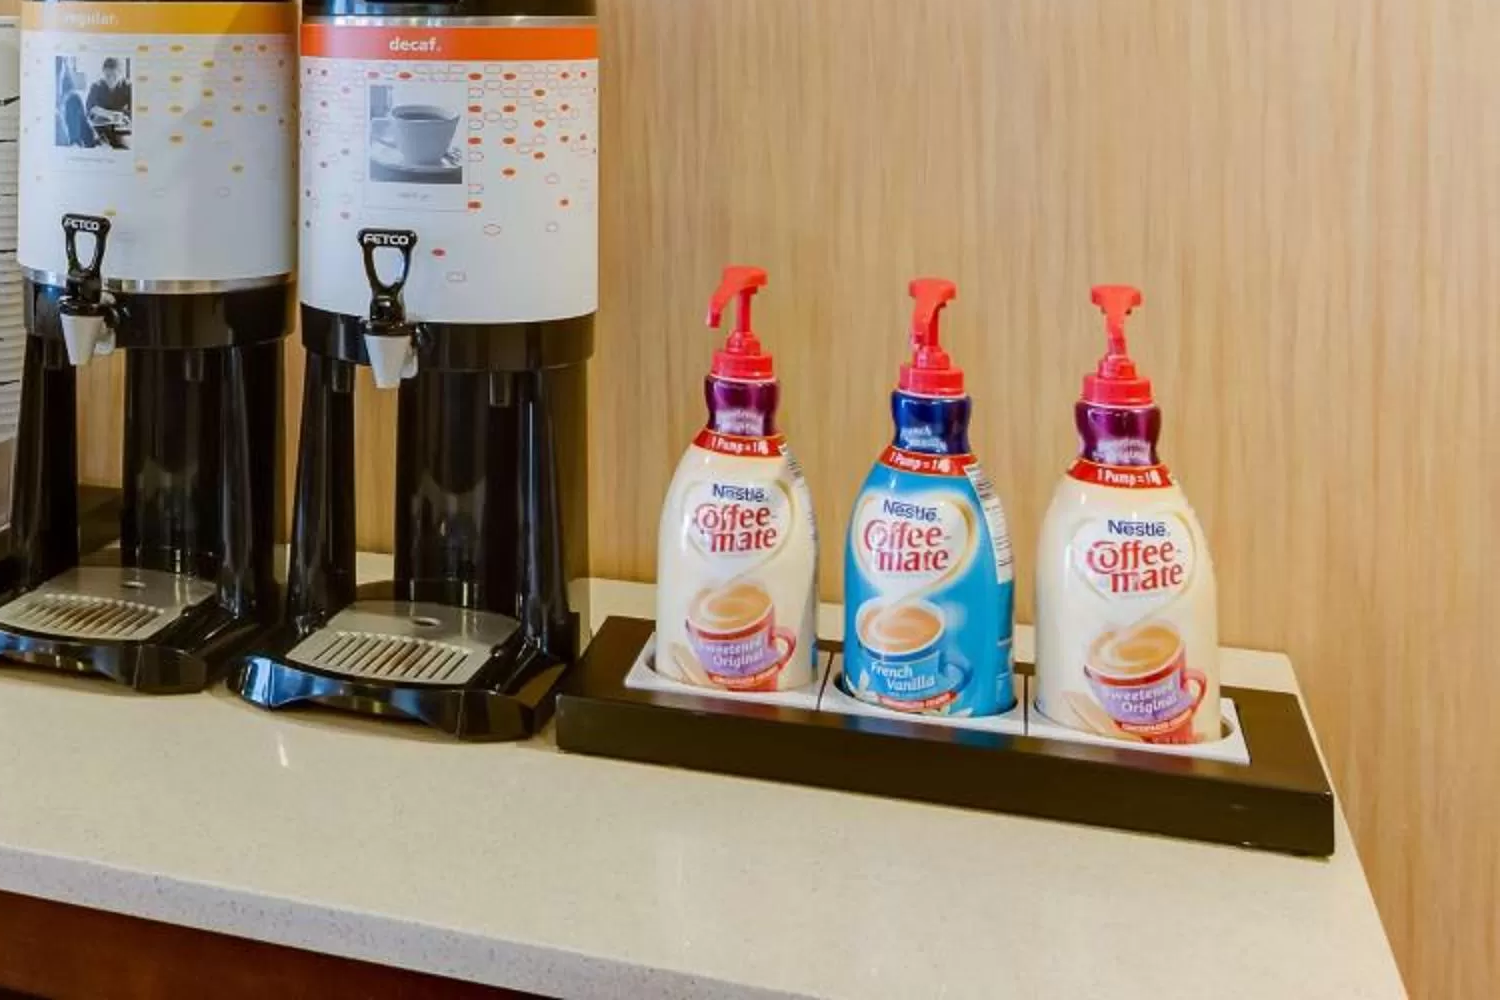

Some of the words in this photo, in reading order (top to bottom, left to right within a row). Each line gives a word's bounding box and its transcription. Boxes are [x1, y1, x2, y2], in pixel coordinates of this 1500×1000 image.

[389, 35, 442, 52] decaf.
[63, 218, 100, 231] FETCO
[363, 232, 409, 245] FETCO
[710, 528, 777, 553] mate
[878, 549, 949, 572] mate
[1110, 564, 1183, 593] mate
[871, 660, 913, 677] French
[886, 674, 935, 691] Vanilla
